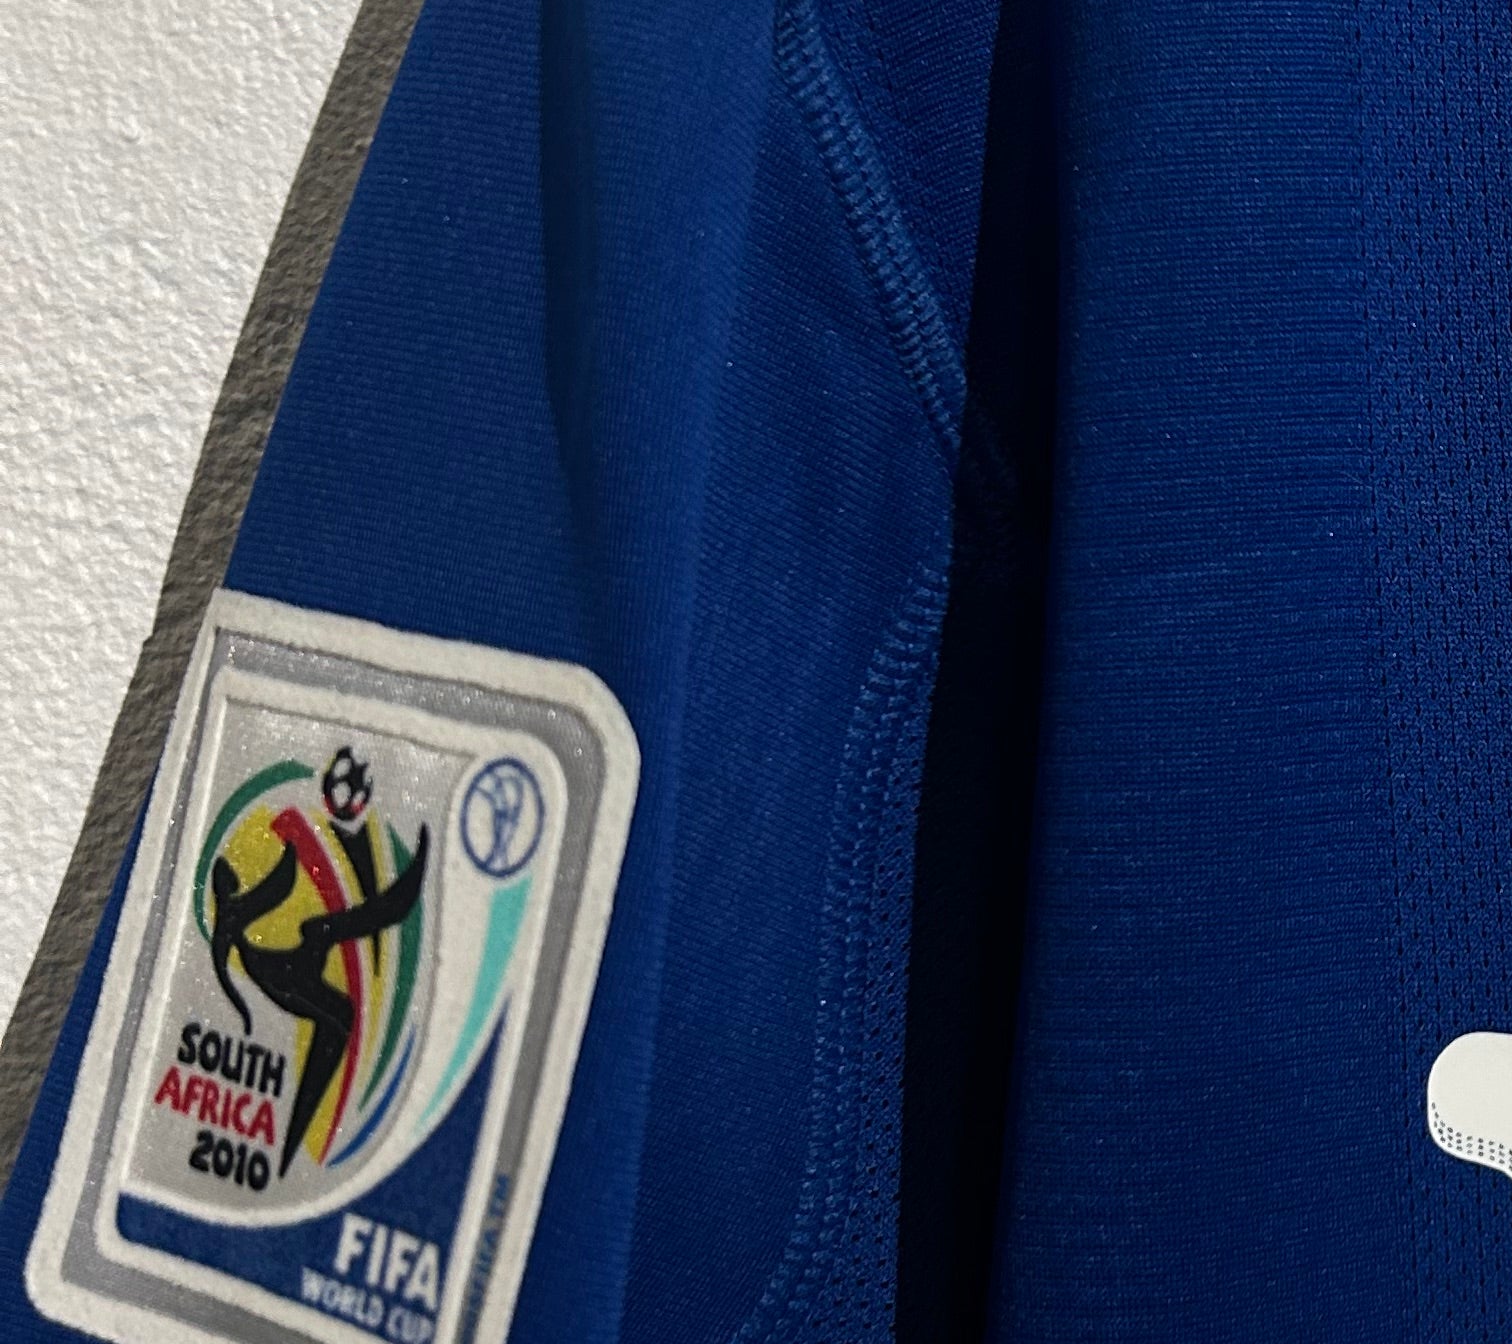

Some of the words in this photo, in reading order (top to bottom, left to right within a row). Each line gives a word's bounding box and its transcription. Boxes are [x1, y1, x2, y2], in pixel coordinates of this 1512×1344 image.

[177, 1022, 286, 1097] SOUTH
[155, 1065, 275, 1146] AFRICA
[189, 1129, 270, 1192] 2010
[301, 1266, 384, 1328] WORLD
[334, 1212, 440, 1312] FIFA
